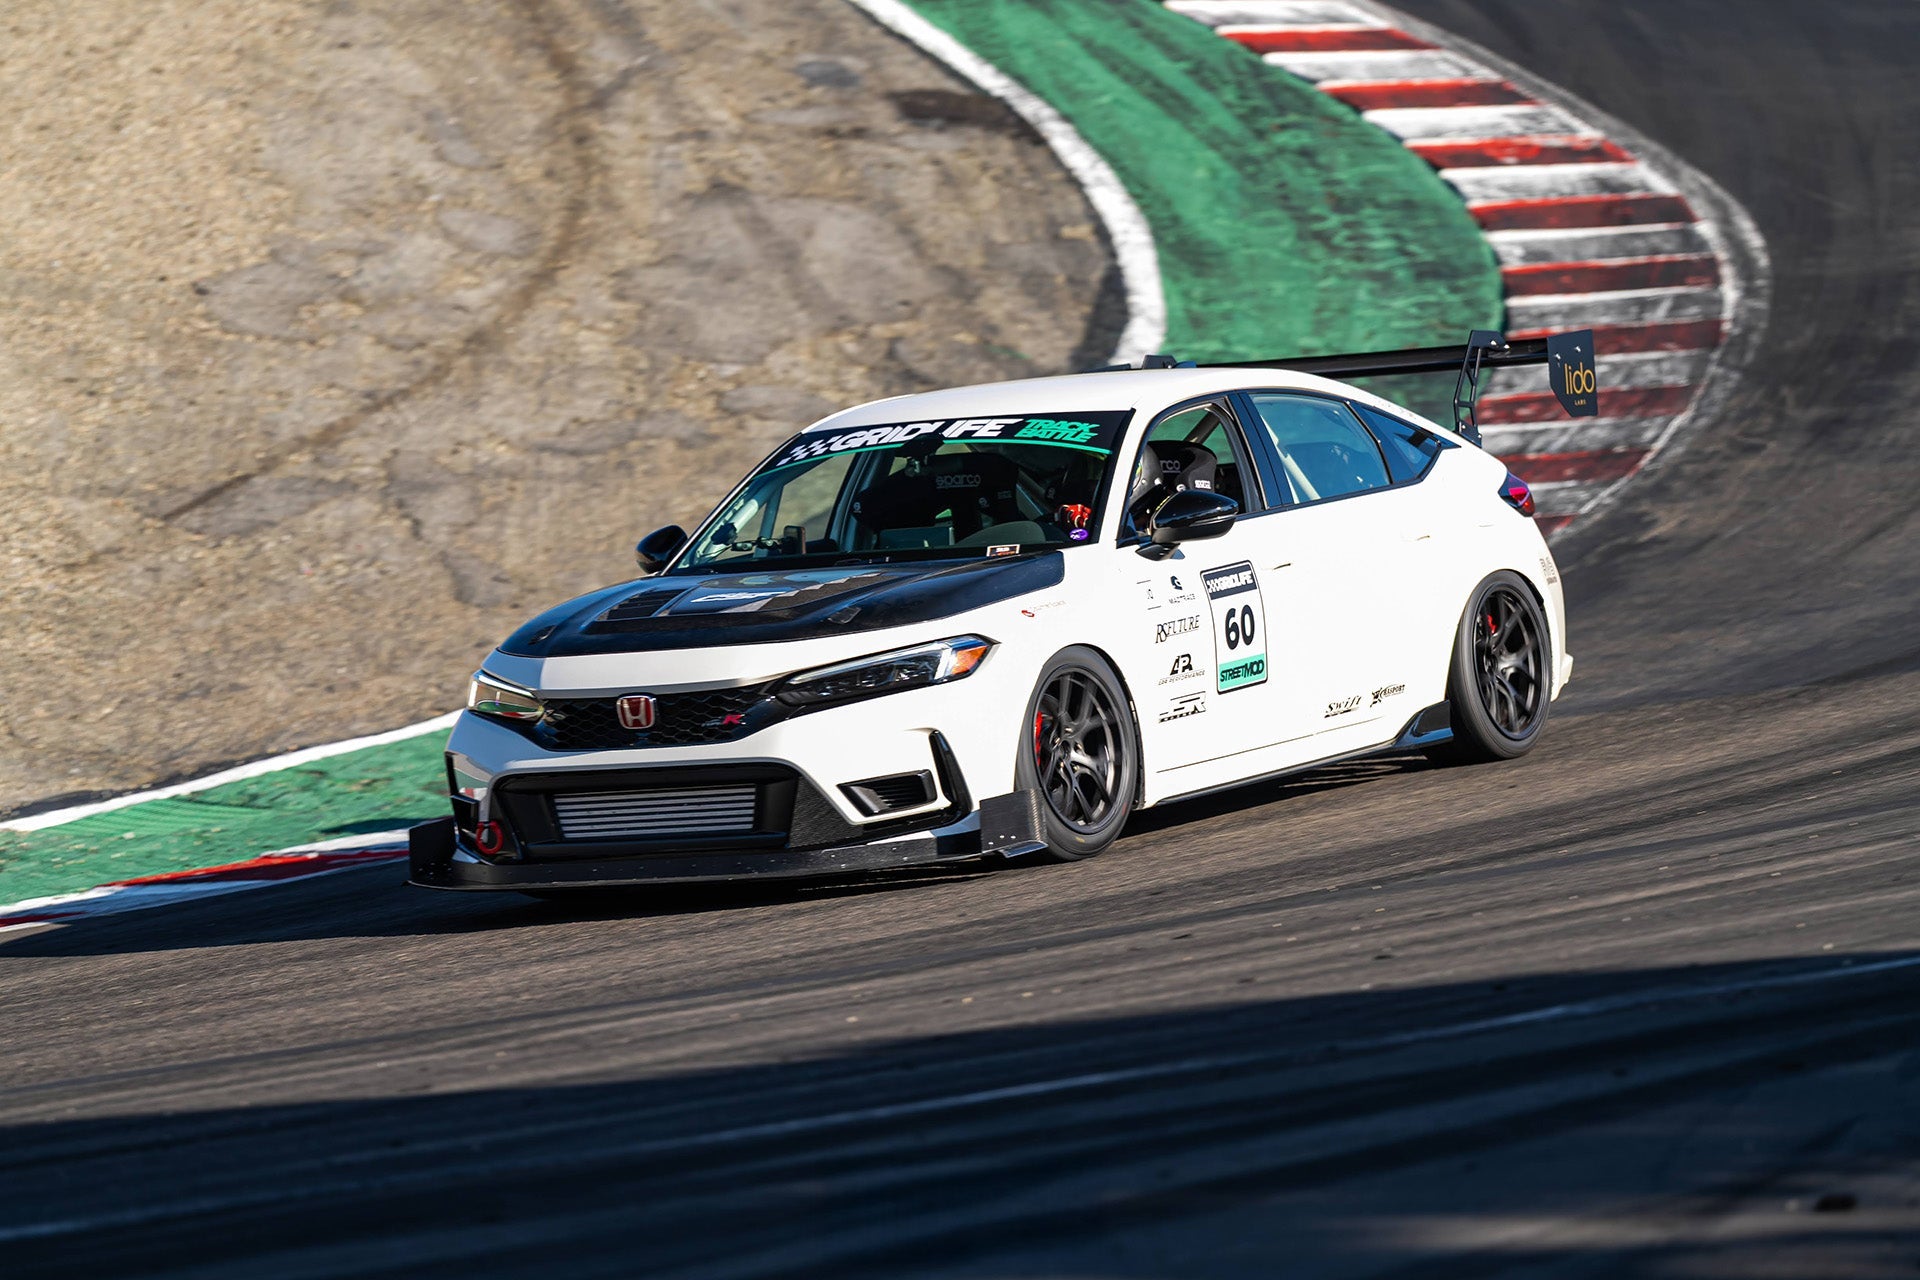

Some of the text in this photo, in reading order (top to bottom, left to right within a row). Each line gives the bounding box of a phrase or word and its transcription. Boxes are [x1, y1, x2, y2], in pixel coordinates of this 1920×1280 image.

[1564, 362, 1595, 394] lido
[1024, 419, 1100, 433] TRACK
[1014, 429, 1098, 443] BATTLE
[936, 474, 980, 487] sparco
[1225, 604, 1255, 650] 60
[1220, 659, 1265, 682] STREETMOD
[1326, 695, 1362, 713] Swift
